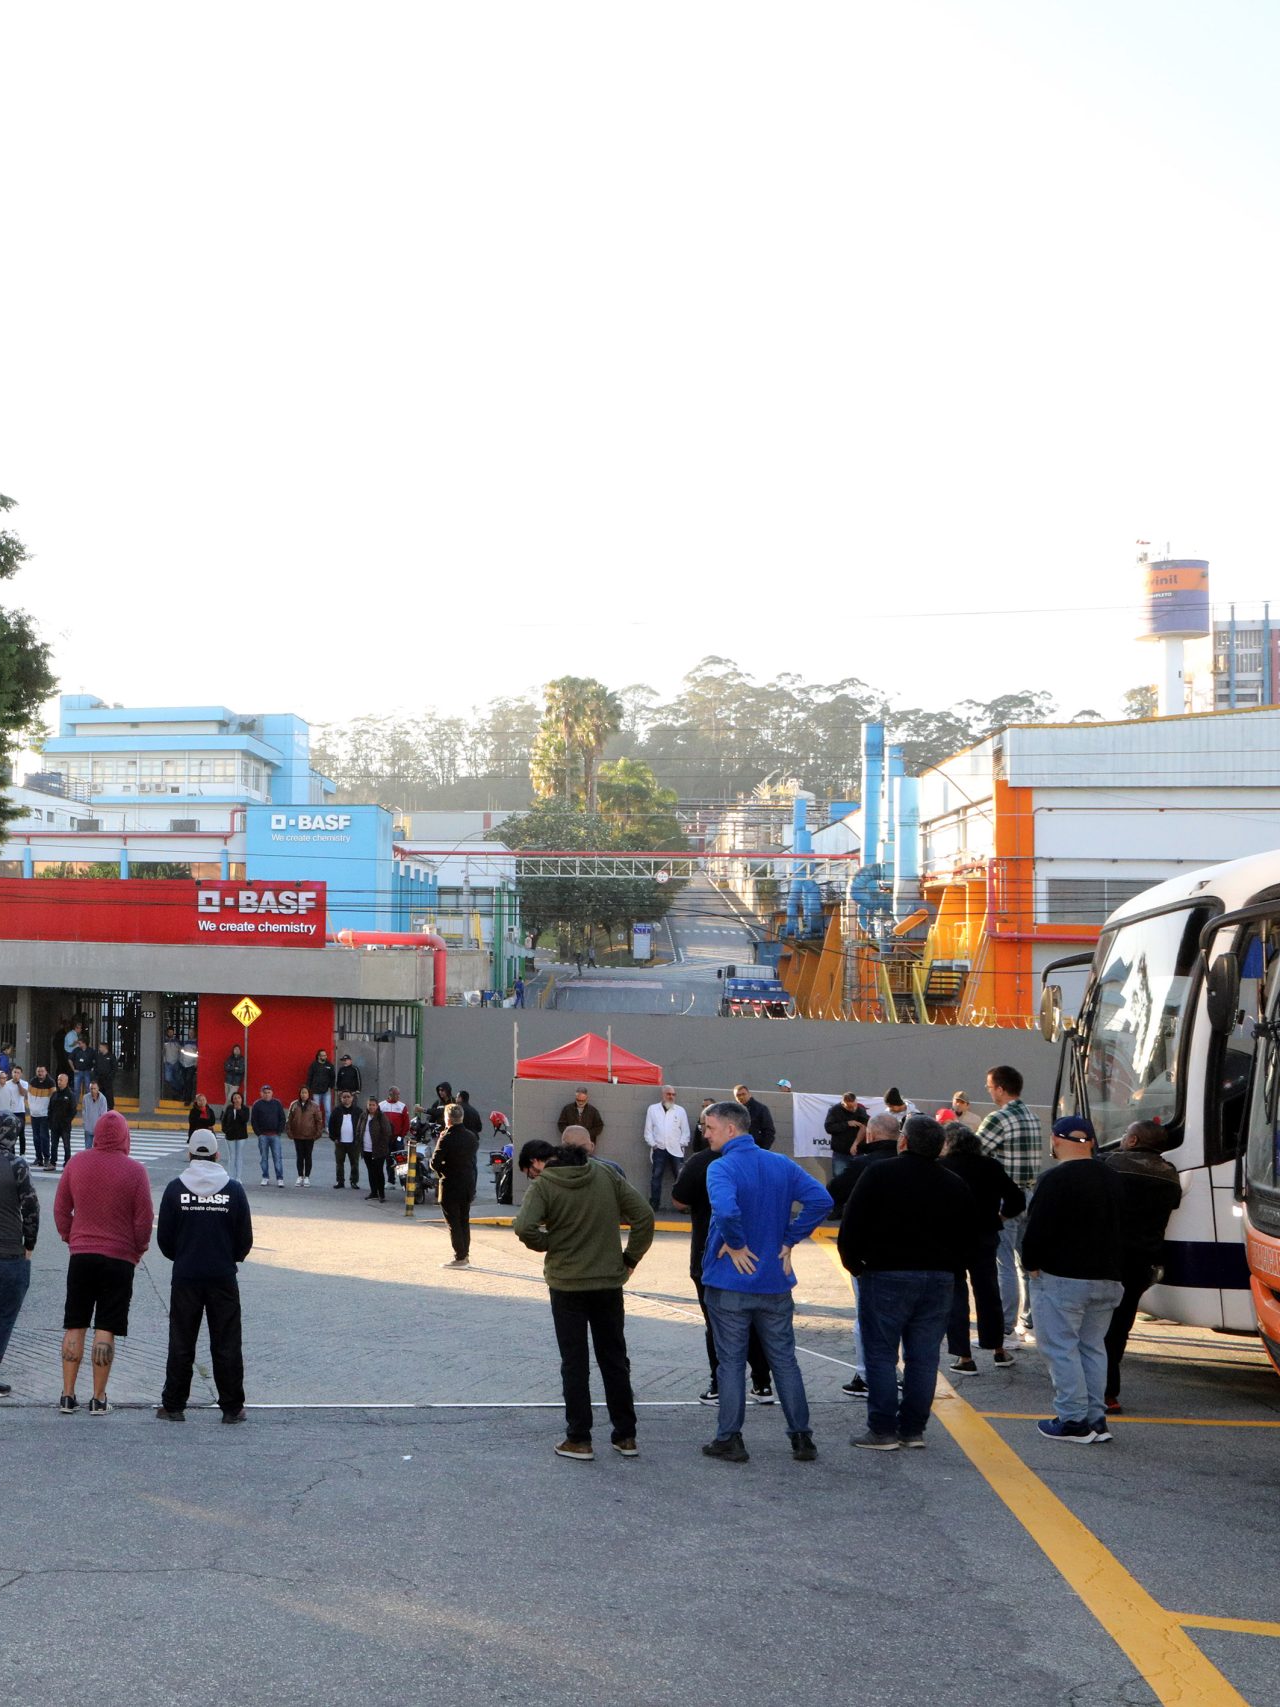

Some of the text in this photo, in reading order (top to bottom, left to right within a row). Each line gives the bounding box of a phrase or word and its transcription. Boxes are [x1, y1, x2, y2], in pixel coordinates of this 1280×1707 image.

[298, 814, 352, 831] BASF
[271, 833, 352, 843] We create chemistry
[238, 890, 317, 915] BASF
[198, 919, 317, 936] We create chemistry
[812, 1137, 831, 1145] indu
[197, 1194, 230, 1205] BASF
[206, 1206, 229, 1214] chemistry
